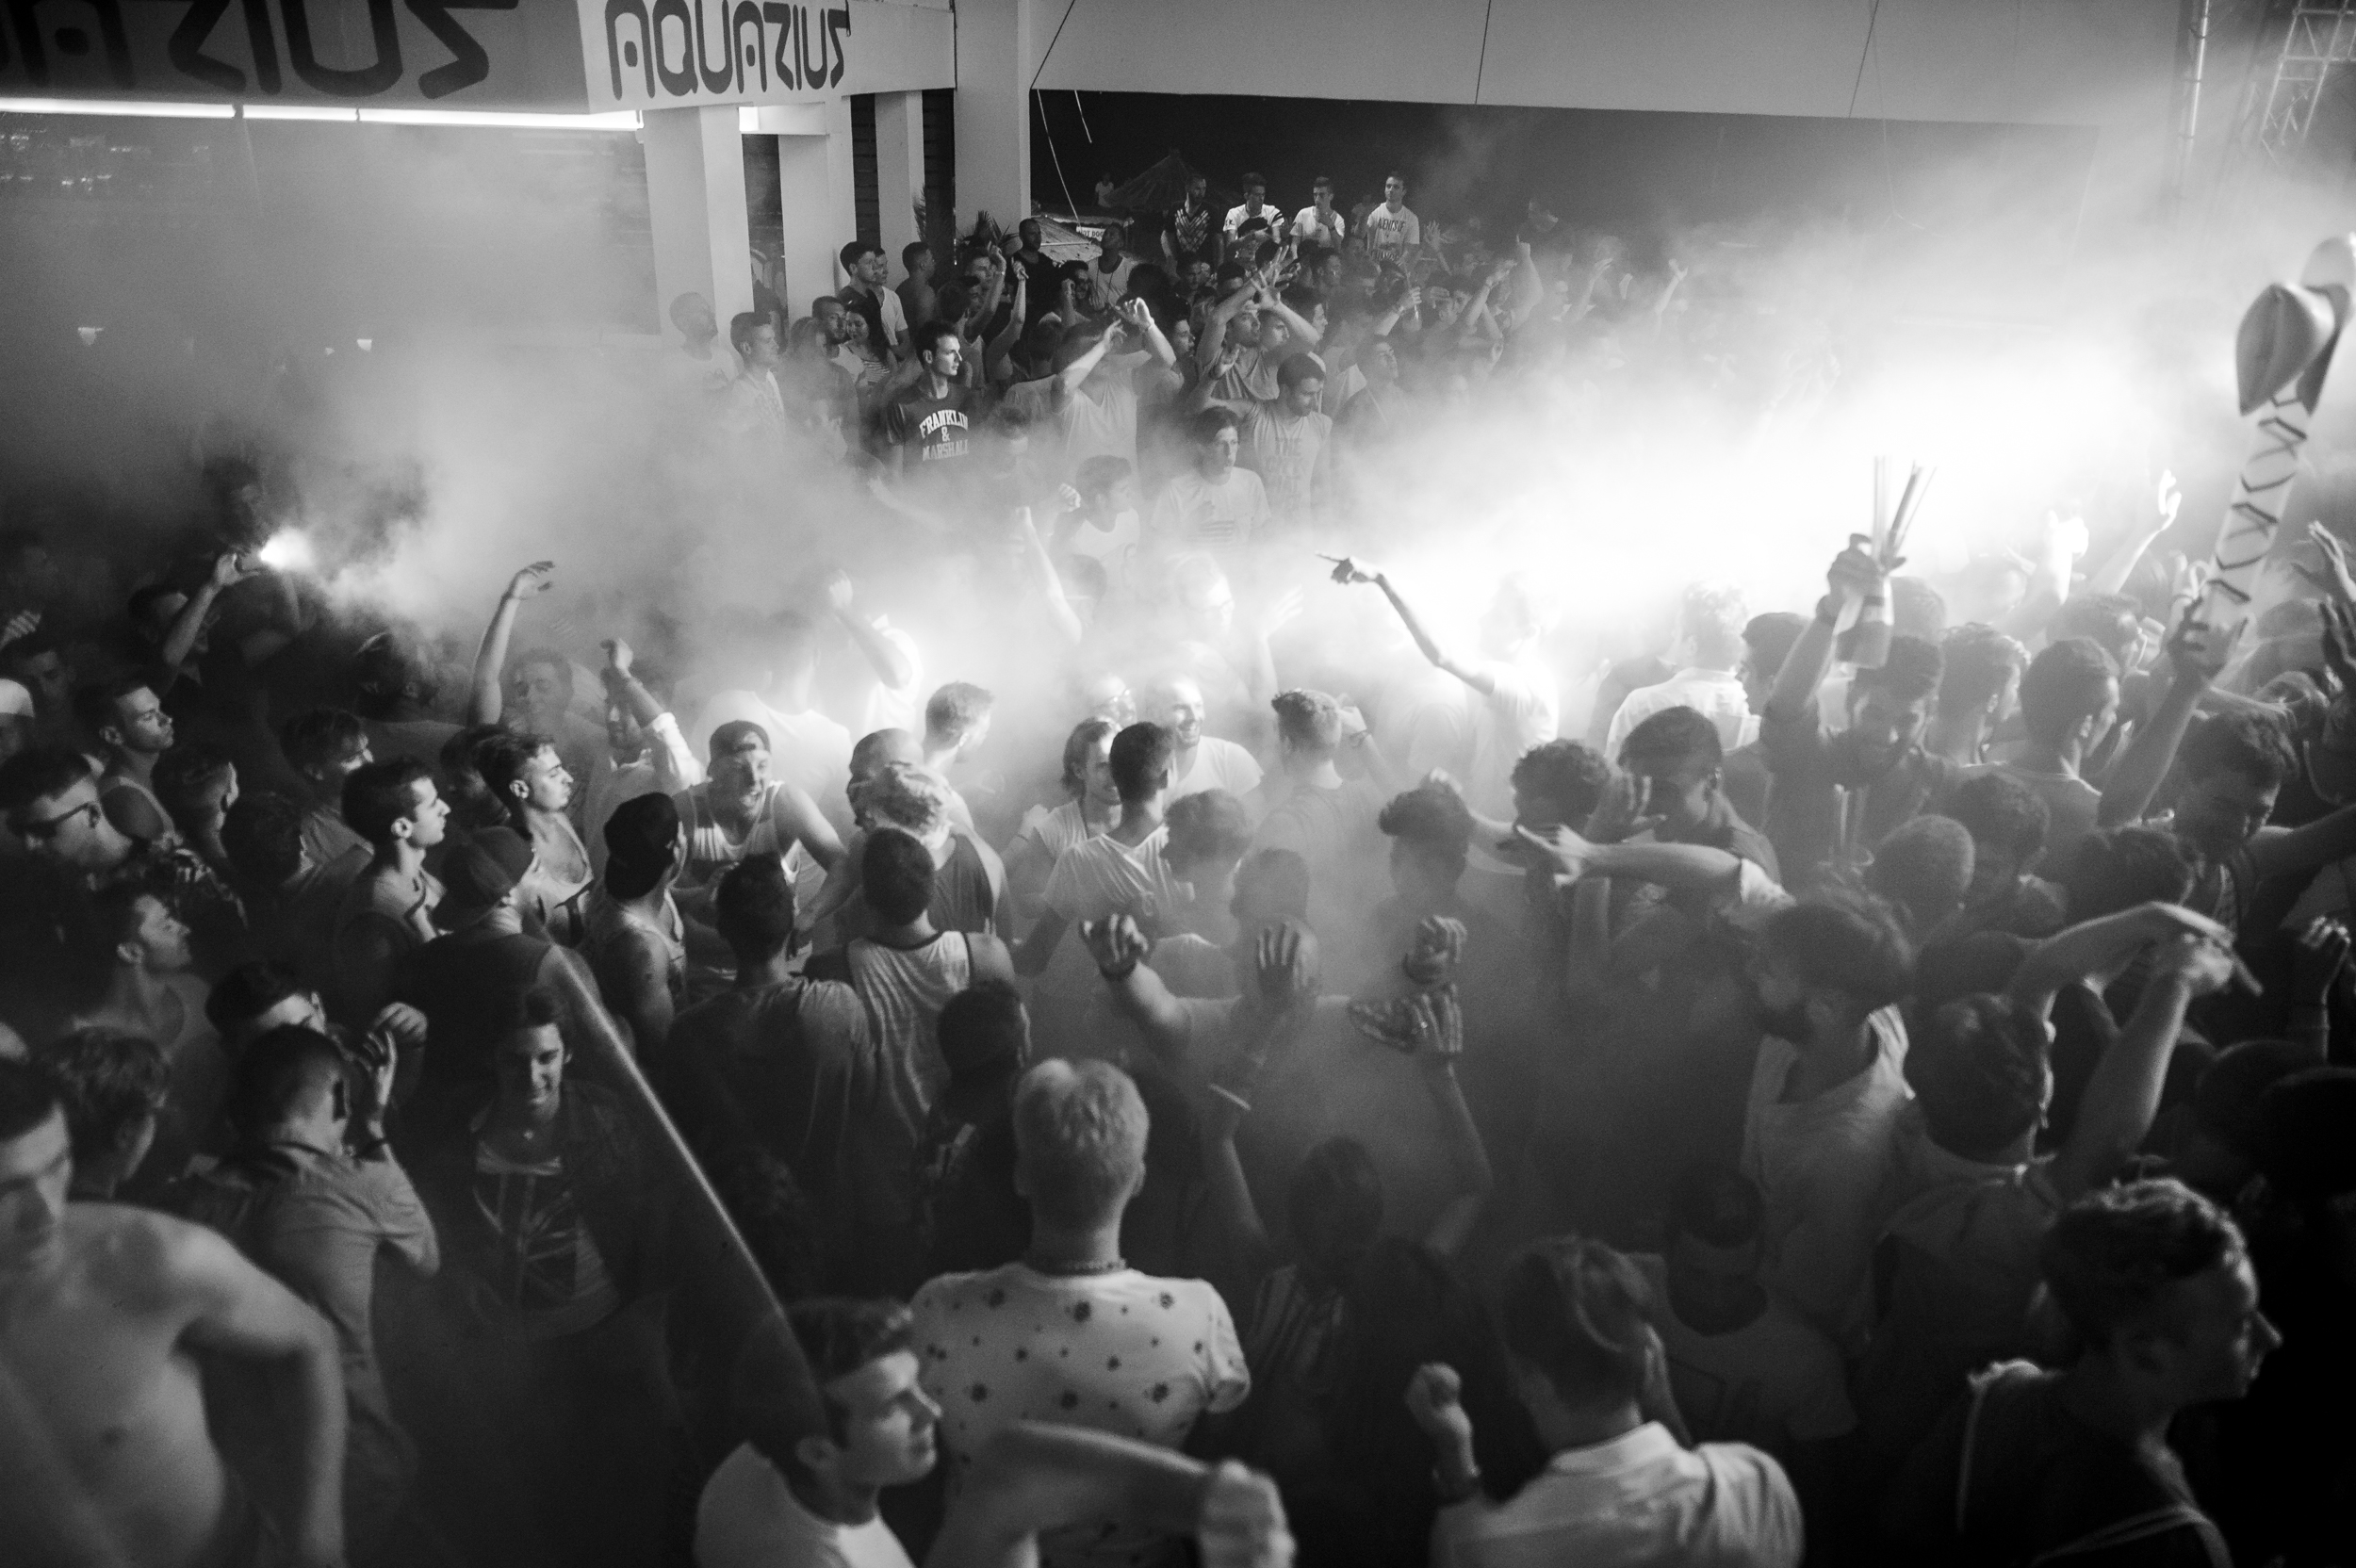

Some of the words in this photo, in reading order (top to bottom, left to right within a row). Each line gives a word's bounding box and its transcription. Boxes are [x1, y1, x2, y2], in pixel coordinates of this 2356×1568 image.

[919, 409, 969, 440] FRANKLIN
[941, 426, 951, 442] &
[922, 438, 969, 462] MARSHALL
